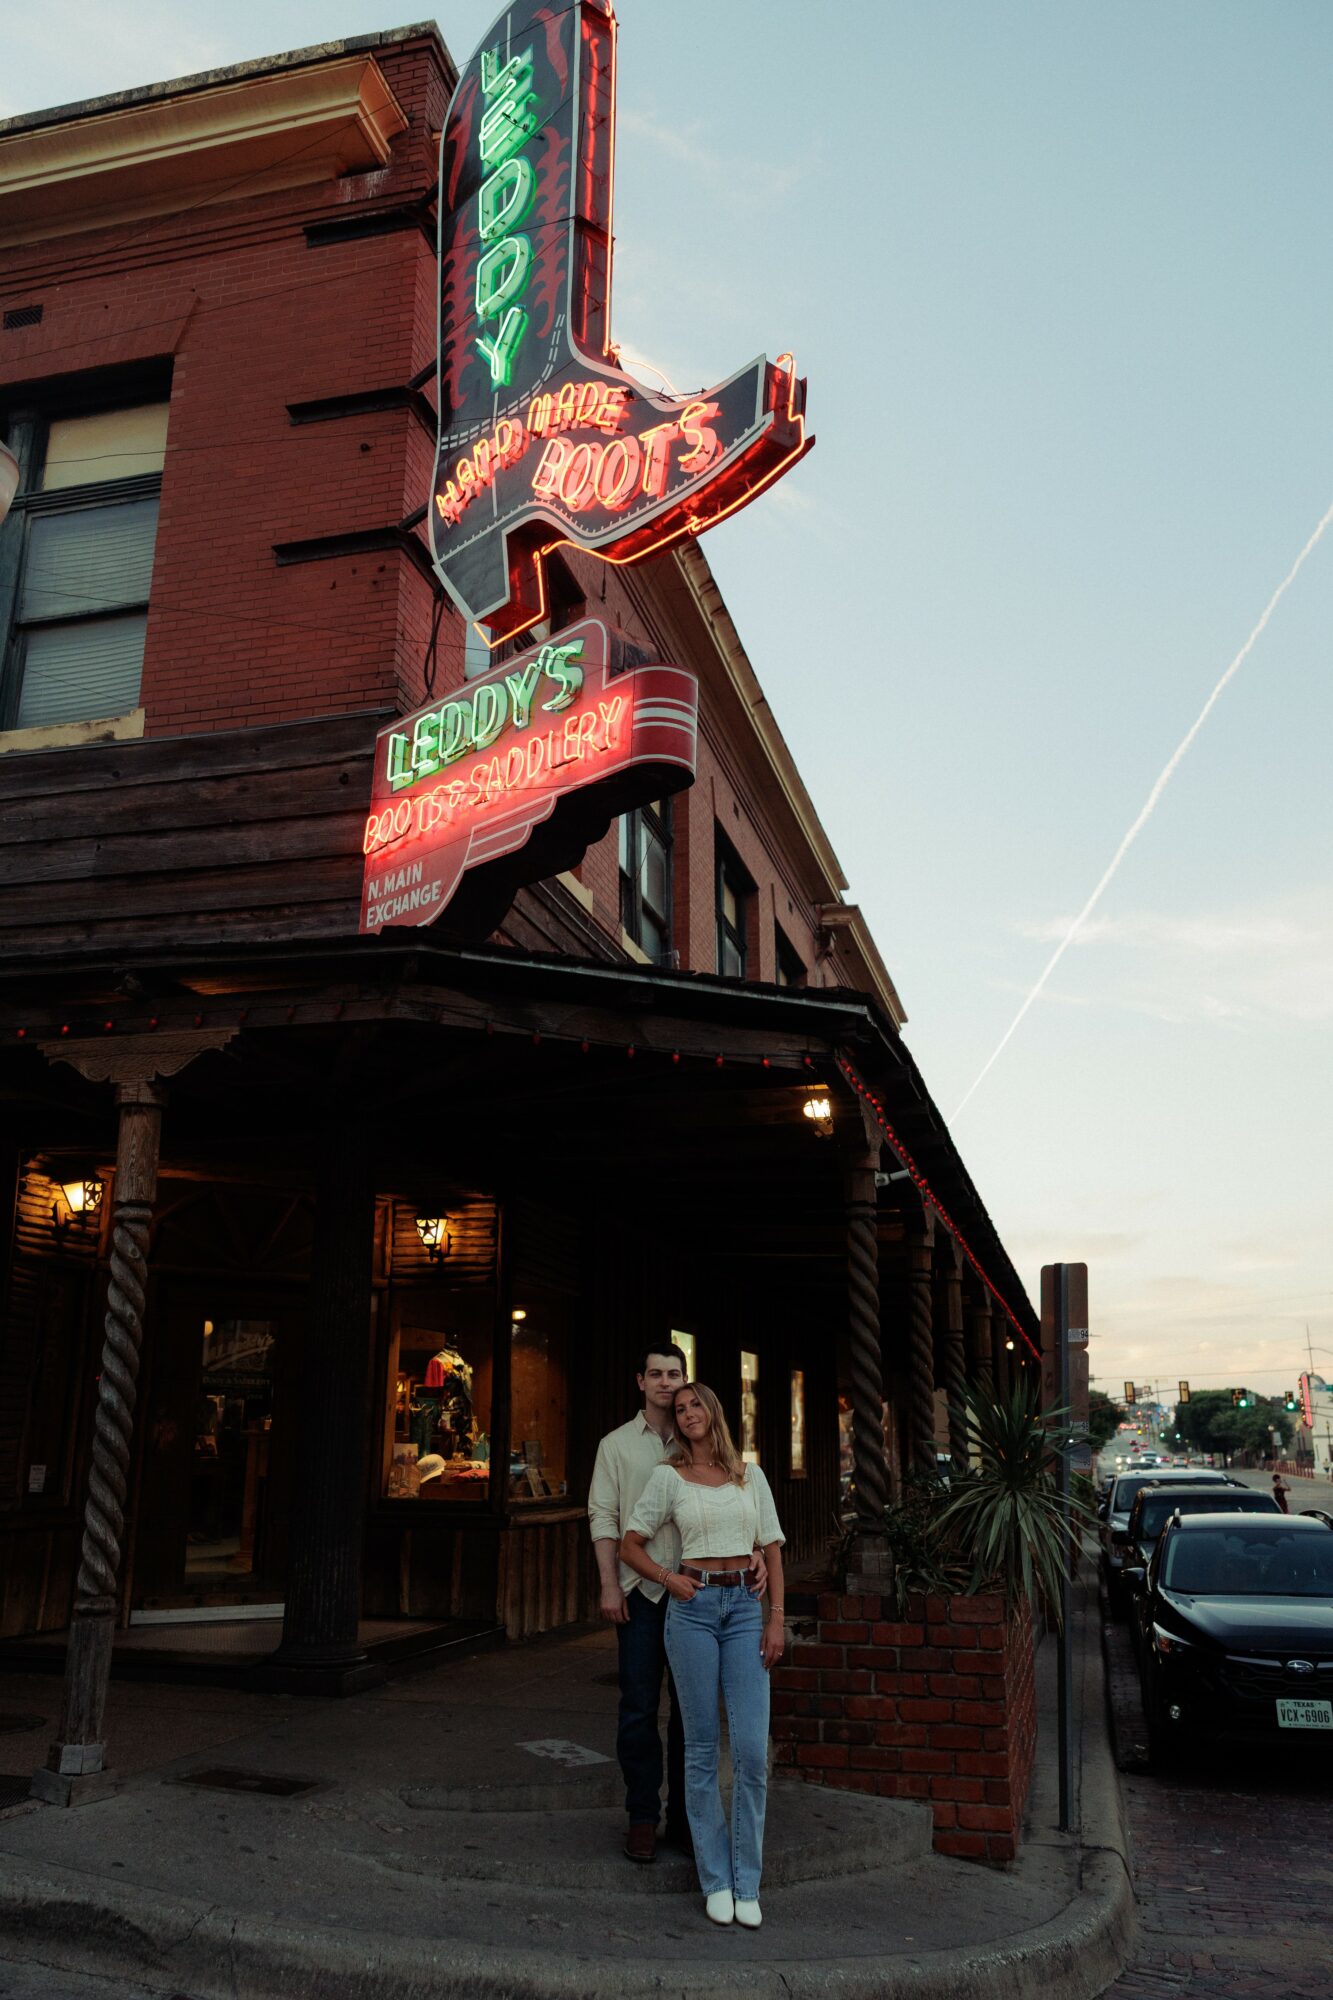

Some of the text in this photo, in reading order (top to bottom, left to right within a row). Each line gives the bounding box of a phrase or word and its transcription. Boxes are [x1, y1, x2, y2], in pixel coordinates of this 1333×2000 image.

[434, 381, 634, 528] HAND MADE
[531, 401, 722, 512] BOOTS
[363, 783, 448, 854] BOOTS
[468, 696, 623, 806] SADDLERY
[386, 640, 585, 791] LEDDY'S
[366, 881, 441, 927] EXCHANGE
